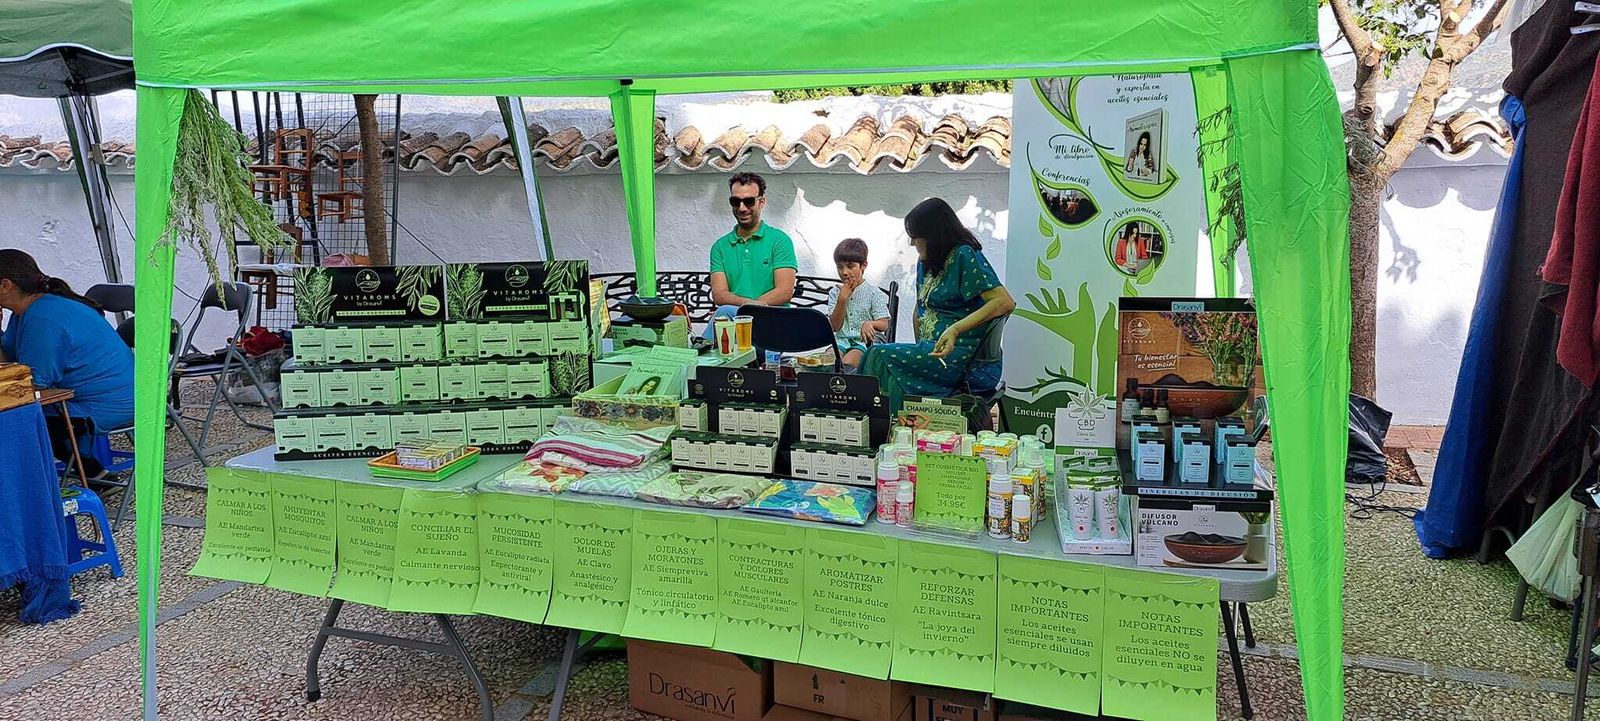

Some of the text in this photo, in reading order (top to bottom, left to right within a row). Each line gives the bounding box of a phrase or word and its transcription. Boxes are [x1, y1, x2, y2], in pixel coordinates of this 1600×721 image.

[1124, 83, 1150, 92] experta
[1107, 93, 1168, 104] aceites esenciales
[1054, 144, 1066, 154] Mi
[1041, 168, 1090, 186] Conferencias
[1112, 206, 1162, 220] Asesoramiento
[1145, 353, 1177, 361] bienestar
[1147, 360, 1176, 368] esencial
[906, 405, 957, 415] CHAMPÚ SÓLIDO
[1014, 406, 1056, 419] Encuéntr
[216, 500, 246, 509] CALMAR
[230, 508, 253, 517] NIÑOS
[284, 512, 325, 526] MOSQUITOS
[229, 522, 264, 532] Mandarina
[346, 515, 376, 526] CALMAR
[384, 520, 398, 528] LOS
[361, 525, 384, 534] NIÑOS
[410, 524, 474, 534] CONCILIAR EL
[494, 526, 540, 539] MUCOSIDAD
[426, 532, 459, 542] SUEÑO
[492, 534, 543, 548] PERSISTENTE
[574, 537, 616, 549] DOLOR DE
[362, 549, 381, 557] verde
[430, 547, 467, 557] Lavanda
[496, 549, 525, 560] Eucalipto
[526, 554, 550, 564] radiata
[577, 546, 612, 557] MUELAS
[656, 545, 690, 555] OJERAS
[400, 560, 442, 570] Calmante
[443, 562, 480, 572] nervioso
[590, 560, 611, 569] Clavo
[648, 553, 704, 566] MORATONES
[729, 555, 794, 569] CONTRACTURAS
[491, 560, 537, 574] Expectorante
[656, 564, 708, 577] Siempreviva
[746, 565, 784, 576] DOLORES
[502, 571, 531, 582] antiviral
[658, 575, 693, 585] amarilla
[734, 571, 789, 584] MUSCULARES
[820, 568, 883, 584] AROMATIZAR
[574, 581, 614, 591] analgésico
[751, 586, 781, 596] Gaulteria
[830, 578, 873, 592] POSTRES
[920, 582, 975, 596] REFORZAR
[636, 588, 714, 602] Tónico circulatorio
[734, 592, 760, 600] Romero
[813, 589, 889, 608] AE Naranja dulce
[921, 592, 974, 606] DEFENSAS
[661, 599, 696, 610] linfático
[743, 600, 773, 610] Eucalipto
[1031, 596, 1069, 609] NOTAS
[814, 604, 886, 624] Excelente tónico
[912, 605, 982, 621] AE Ravintsara
[1010, 603, 1089, 623] IMPORTANTES
[1140, 611, 1181, 624] NOTAS
[829, 617, 870, 630] digestivo
[935, 621, 958, 634] joya
[960, 624, 976, 634] del
[1022, 618, 1077, 635] Los aceites
[1118, 619, 1204, 638] IMPORTANTES
[1004, 626, 1094, 648] esenciales se usan
[1130, 635, 1190, 650] Los aceites
[1006, 636, 1091, 658] siempre diluidos
[1115, 644, 1205, 662] esenciales NO se
[1116, 654, 1203, 673] diluyen en agua
[650, 672, 736, 714] Drasanvi
[813, 694, 825, 704] FR
[942, 704, 963, 714] MUY
